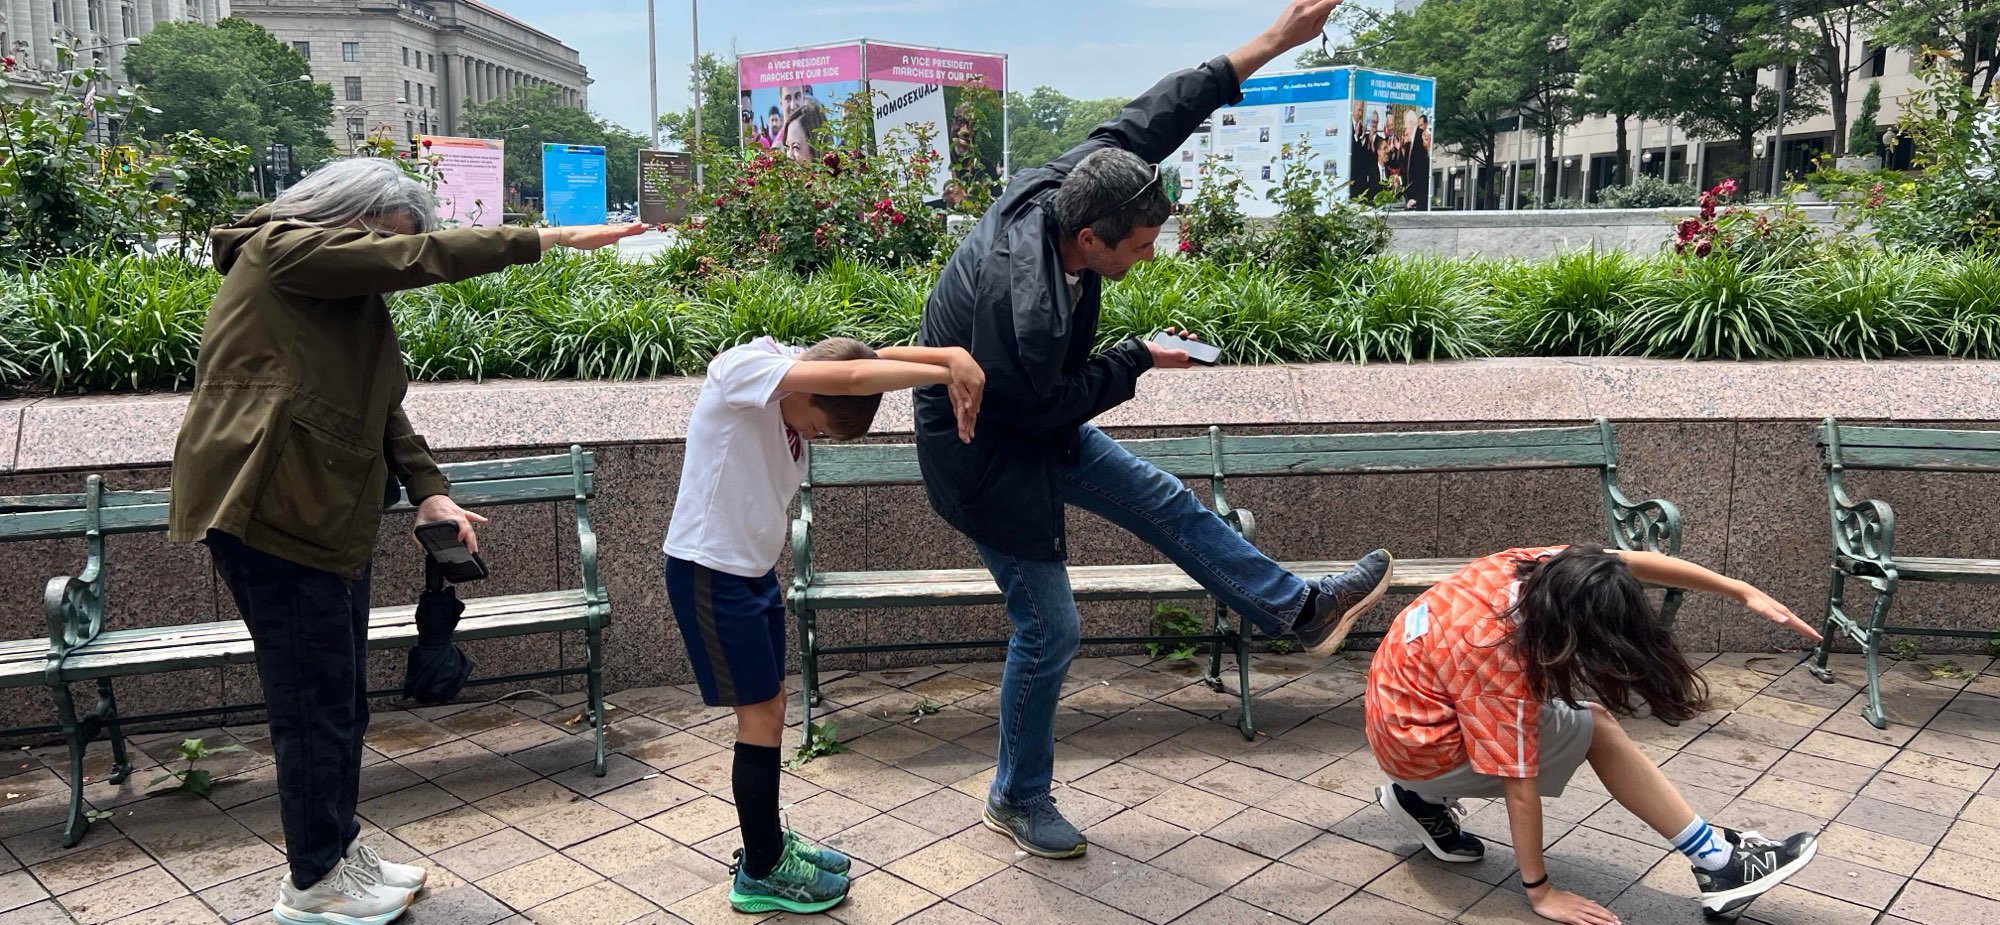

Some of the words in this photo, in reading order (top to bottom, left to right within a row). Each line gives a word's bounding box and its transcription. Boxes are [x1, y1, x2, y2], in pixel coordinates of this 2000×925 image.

[768, 62, 773, 70] A
[774, 60, 791, 70] VICE
[792, 56, 830, 68] PRESIDENT
[902, 55, 909, 64] A
[910, 56, 931, 66] VICE
[932, 58, 974, 70] PRESIDENT
[760, 71, 794, 83] MARCHES
[795, 70, 804, 80] BY
[806, 69, 821, 79] OUR
[822, 67, 840, 77] SIDE
[892, 66, 934, 78] MARCHES
[935, 70, 946, 79] BY
[947, 71, 965, 81] OUR
[1375, 80, 1387, 88] NEW
[1387, 81, 1409, 91] ALLIANCE
[1410, 84, 1420, 92] FOR
[876, 83, 939, 120] HOMOSEXUALS
[1378, 90, 1389, 98] NEW
[1743, 850, 1777, 883] N
